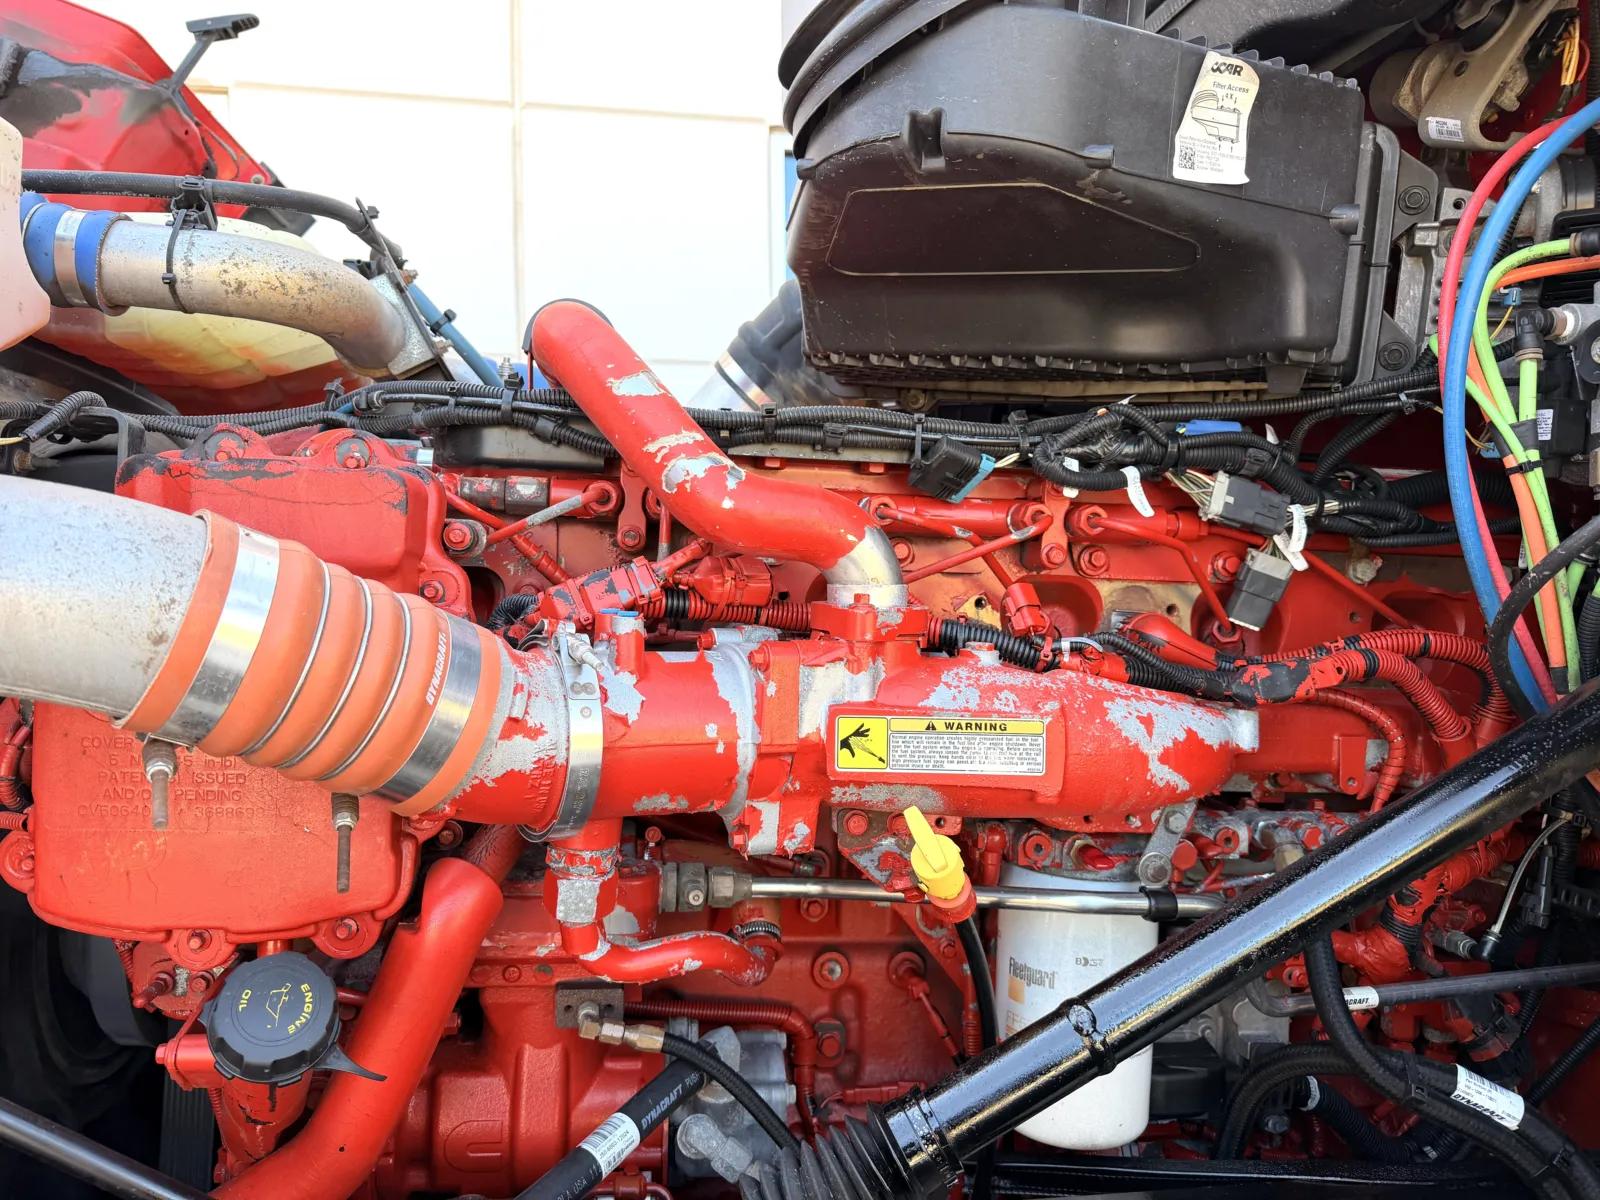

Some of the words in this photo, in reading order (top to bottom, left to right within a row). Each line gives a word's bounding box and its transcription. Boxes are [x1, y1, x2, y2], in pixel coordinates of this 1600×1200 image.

[1227, 84, 1249, 93] Access
[944, 721, 1008, 732] WARNING
[80, 736, 134, 750] COVER
[191, 772, 248, 785] ISSUED
[102, 787, 152, 801] AND/O
[174, 788, 243, 801] PENDING
[1009, 956, 1056, 990] Fleetguard
[239, 989, 252, 1012] OIL
[287, 983, 313, 1034] ENGINE
[641, 1083, 683, 1130] DYNACRAFT
[1453, 1093, 1506, 1121] DYNACRAFT
